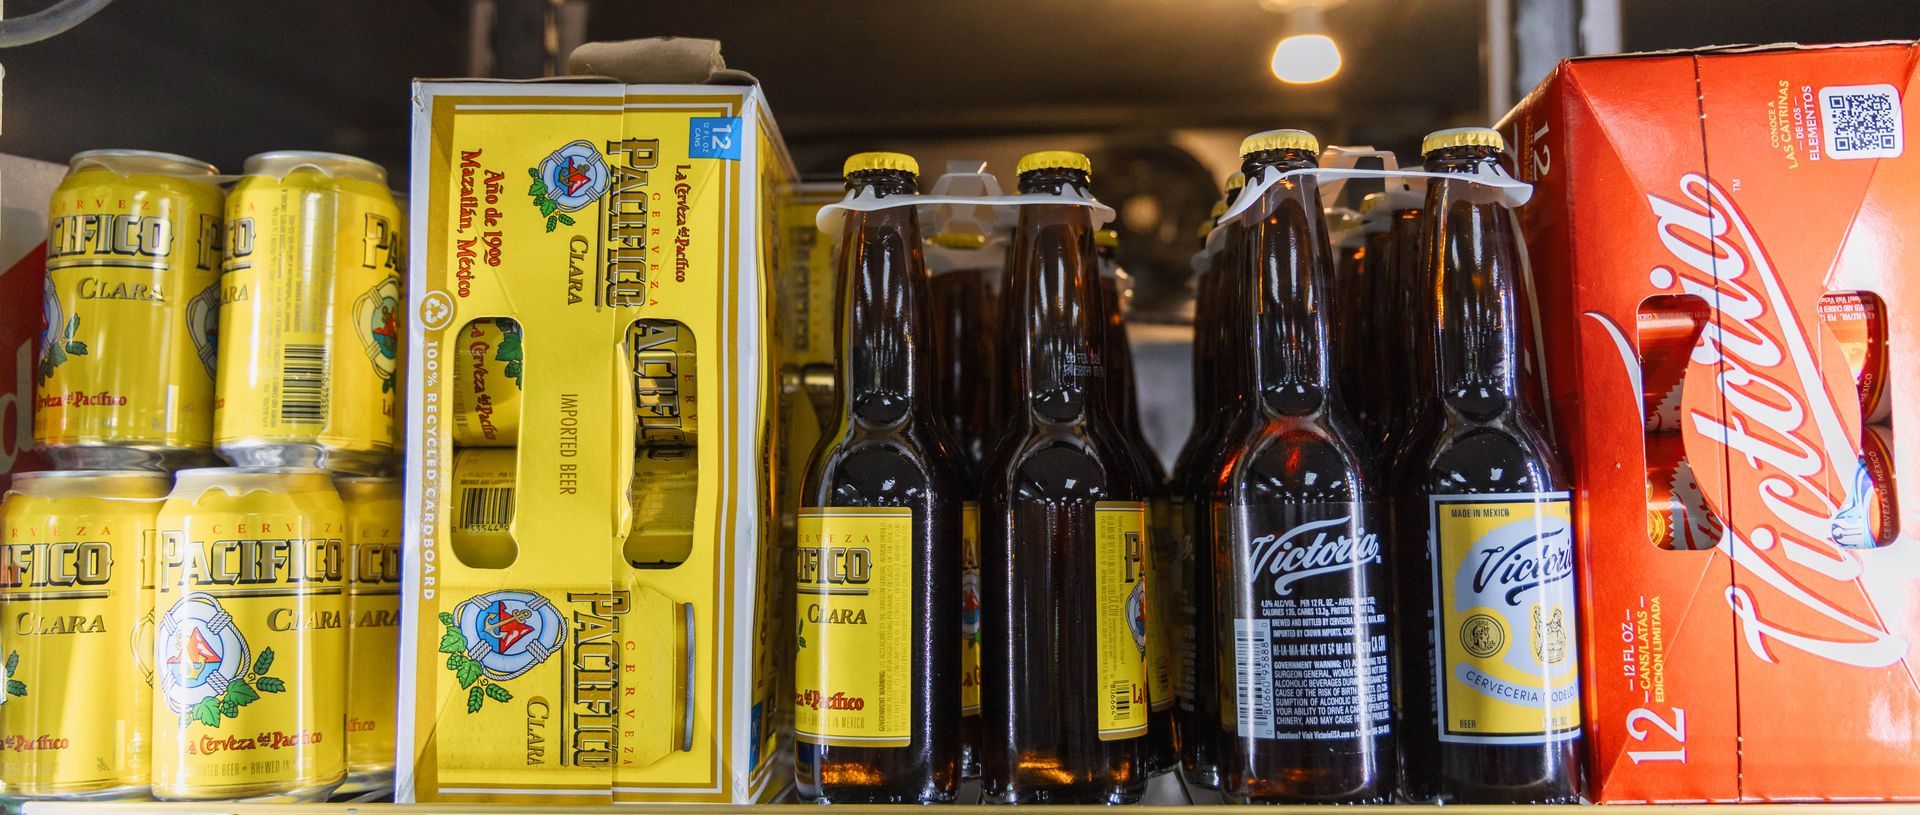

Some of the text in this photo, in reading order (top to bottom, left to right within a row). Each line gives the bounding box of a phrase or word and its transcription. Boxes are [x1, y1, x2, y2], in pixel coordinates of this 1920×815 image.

[702, 130, 709, 140] FL
[711, 122, 732, 150] 12
[1767, 101, 1780, 149] CONOCE A
[1778, 79, 1799, 170] LAS CATRINAS
[1793, 107, 1804, 139] DE LOS
[1801, 85, 1820, 161] ELEMENTOS
[702, 142, 709, 154] OZ
[1534, 120, 1551, 181] 12
[674, 164, 692, 182] La
[481, 169, 506, 267] Año de 1900
[674, 183, 692, 226] Cerveza
[456, 148, 483, 299] Mazatlán, México
[606, 137, 660, 308] PACIFICO
[677, 226, 690, 238] del
[650, 192, 661, 307] CERVEZA
[567, 234, 589, 307] CLARA
[77, 276, 167, 303] CLARA
[222, 284, 249, 305] ARA
[470, 341, 491, 394] Cerveza
[683, 350, 698, 425] CERV
[1584, 171, 1908, 668] Victoria
[559, 393, 578, 497] IMPORTED BEER
[422, 341, 439, 600] 100% RECYCLED CARDBOARD
[1878, 482, 1888, 496] DE
[212, 522, 344, 535] CERVZA
[1451, 507, 1510, 518] MADE IN MEXICO
[1879, 497, 1890, 541] CERVEZA
[160, 530, 345, 593] PACIFICO
[1249, 515, 1379, 596] Victoria
[808, 602, 868, 625] CLARA
[1262, 608, 1285, 616] CALORIES
[1297, 607, 1314, 616] CARBS
[1331, 606, 1350, 615] PROTEIN
[1300, 599, 1310, 607] PER
[1311, 599, 1317, 607] 12
[16, 611, 107, 636] CLARA
[1272, 618, 1290, 627] BREWED
[1291, 618, 1301, 627] AND
[1302, 617, 1322, 626] BOTTLED
[1322, 617, 1328, 626] BY
[1272, 629, 1296, 638] IMPORTED
[1296, 629, 1303, 637] BY
[1303, 628, 1321, 637] CROWN
[1260, 641, 1270, 676] 95888
[1273, 661, 1313, 670] GOVERNMENT
[1621, 622, 1636, 677] 12 FL OZ
[1636, 610, 1652, 690] CANS/LATAS
[1650, 595, 1665, 703] EDICIÓN LIMITADA
[567, 589, 632, 769] PACIFICO
[1274, 670, 1303, 679] SURGEON
[1332, 668, 1354, 678] WOMEN
[1275, 678, 1342, 688] ALCOHOLIC BEVERAGES
[1465, 670, 1539, 702] CERVECERIA
[623, 639, 636, 766] CERVEZA
[1263, 681, 1272, 716] 80660
[1275, 688, 1295, 697] CAUSE
[1295, 688, 1304, 697] OF
[1305, 688, 1317, 697] THE
[1317, 688, 1332, 697] RISK
[1332, 687, 1340, 697] OF
[1341, 686, 1357, 696] BIRTH
[1275, 697, 1308, 706] SUMPTION
[1310, 697, 1318, 706] OF
[1320, 696, 1351, 706] ALCOHOLIC
[878, 697, 886, 732] GOVERNMENT
[1275, 707, 1293, 716] YOUR
[1294, 707, 1317, 716] ABILITY
[1317, 706, 1326, 715] TO
[1327, 705, 1344, 715] DRIVE
[1276, 716, 1304, 726] CHINERY,
[1305, 716, 1318, 725] AND
[1320, 715, 1334, 725] MAY
[1334, 714, 1353, 724] CAUSE
[1459, 719, 1477, 729] BEER
[199, 733, 257, 757] Cerveza
[256, 731, 272, 748] del
[527, 695, 551, 766] CLARA
[1625, 706, 1687, 765] 12
